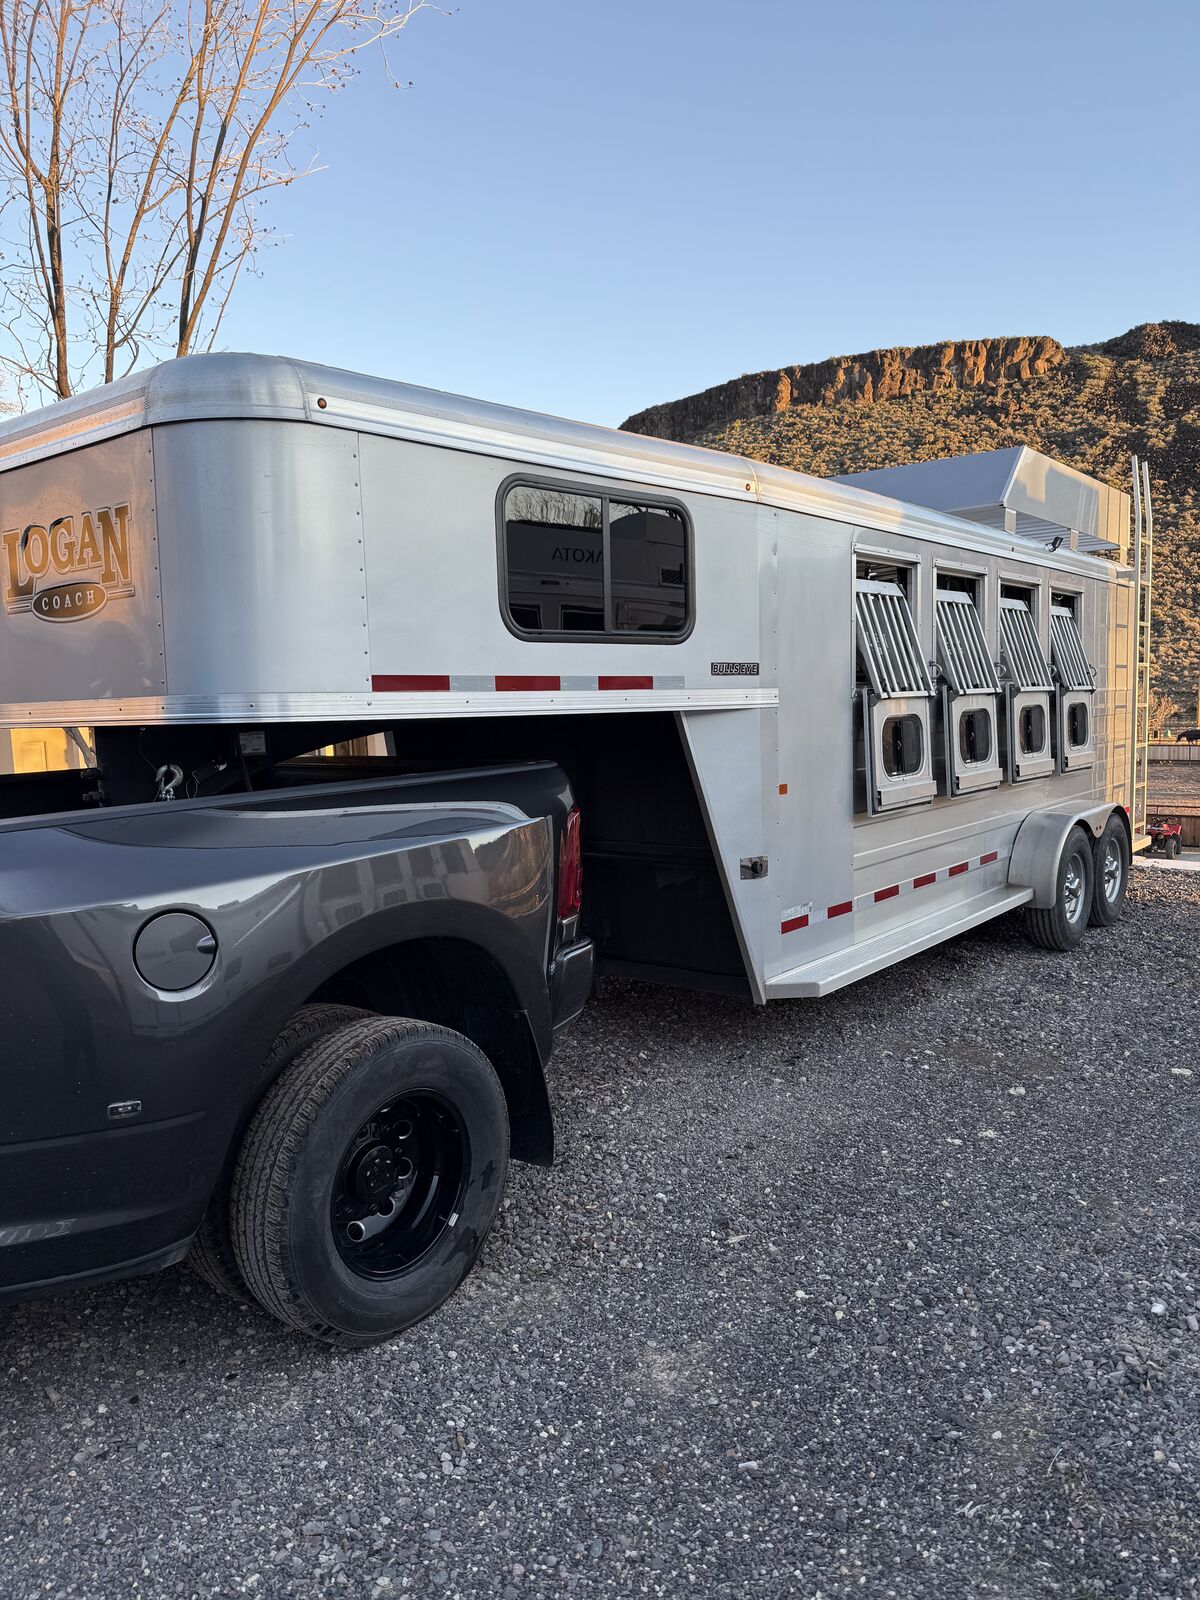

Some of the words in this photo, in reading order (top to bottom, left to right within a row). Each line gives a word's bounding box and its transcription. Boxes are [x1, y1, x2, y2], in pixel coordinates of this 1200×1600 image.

[2, 502, 132, 600] LOGAN
[42, 590, 95, 610] COACH
[711, 663, 758, 674] BULLSEYE
